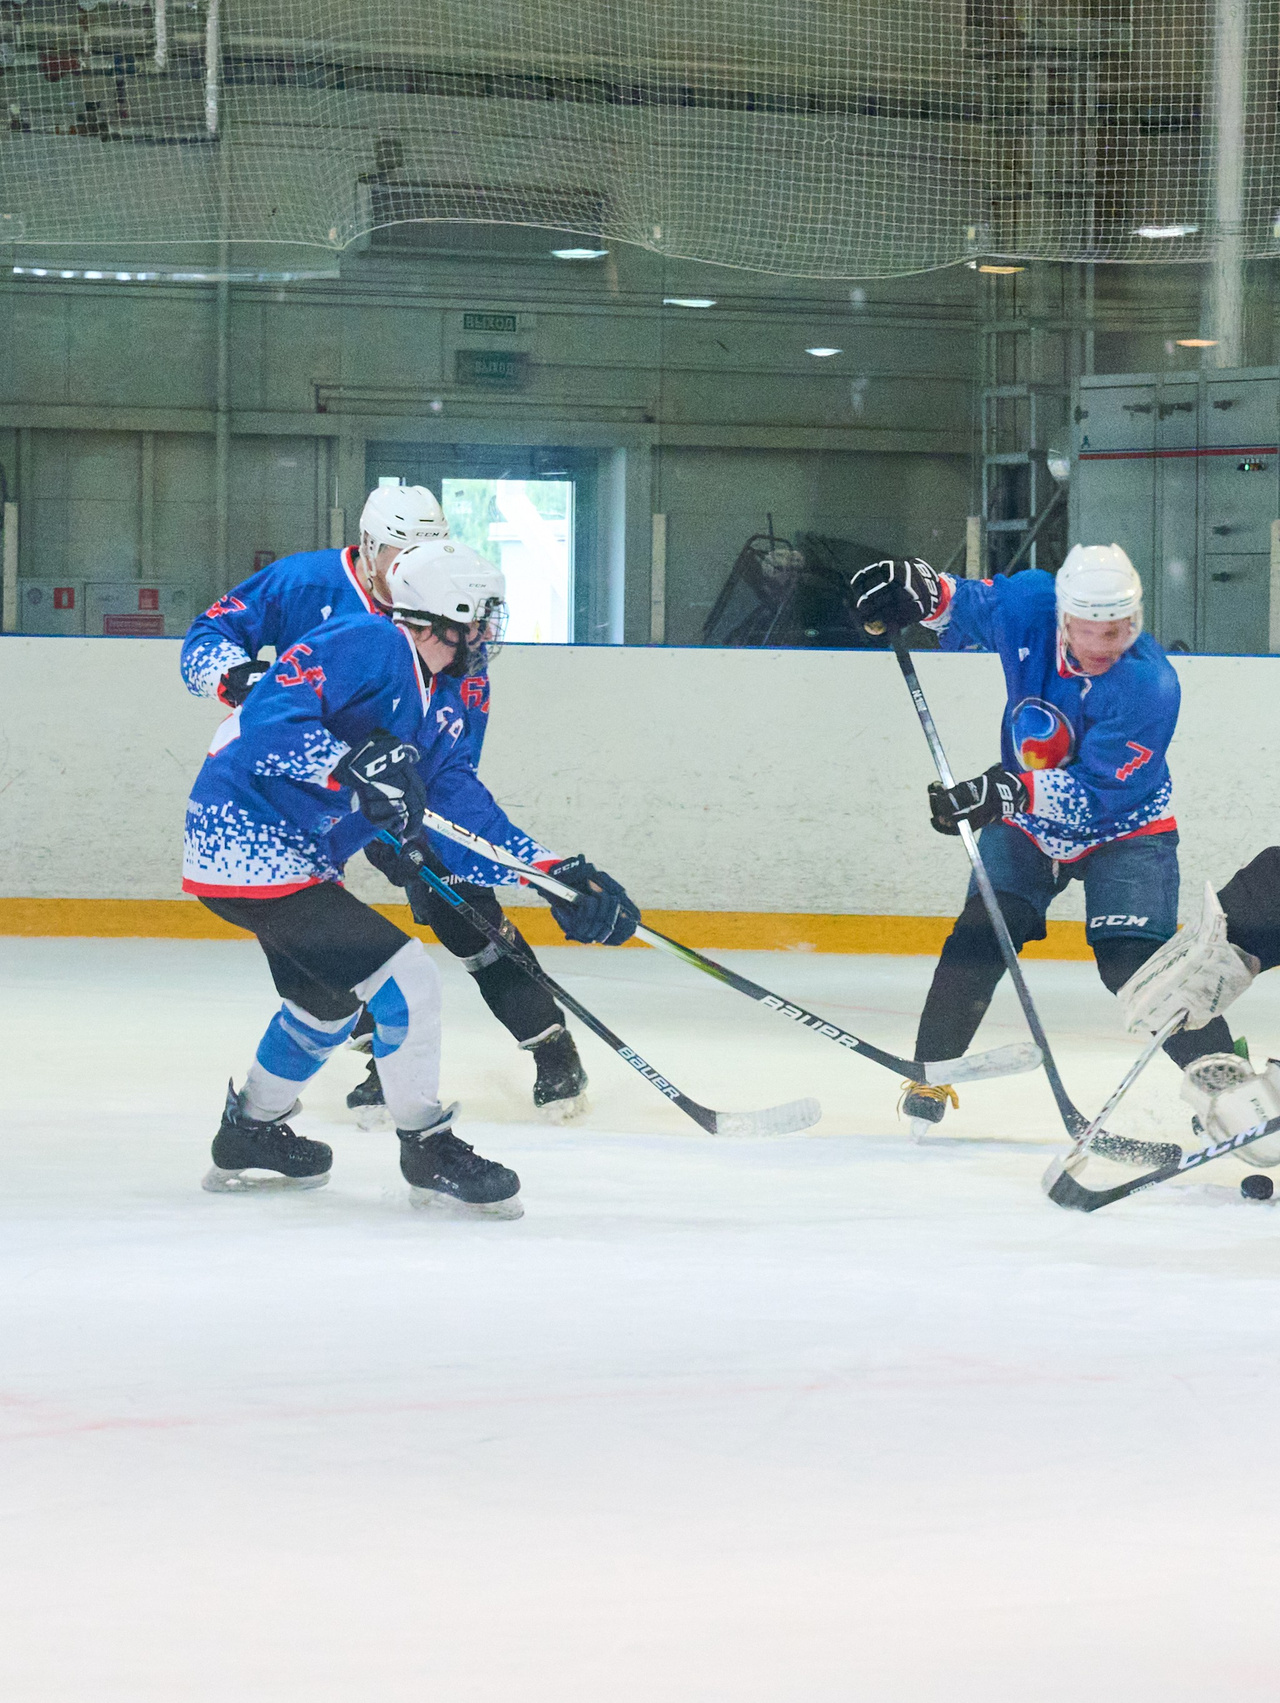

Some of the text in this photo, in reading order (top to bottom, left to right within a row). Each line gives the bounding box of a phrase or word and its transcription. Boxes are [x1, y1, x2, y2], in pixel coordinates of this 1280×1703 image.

[465, 315, 514, 331] ВЫХОД
[364, 744, 408, 777] CC
[1115, 740, 1154, 782] 7
[553, 860, 580, 876] CCM
[1089, 914, 1149, 929] CCM
[760, 995, 860, 1049] BAUER
[617, 1046, 681, 1100] BAUER
[1178, 1121, 1268, 1170] CCM
